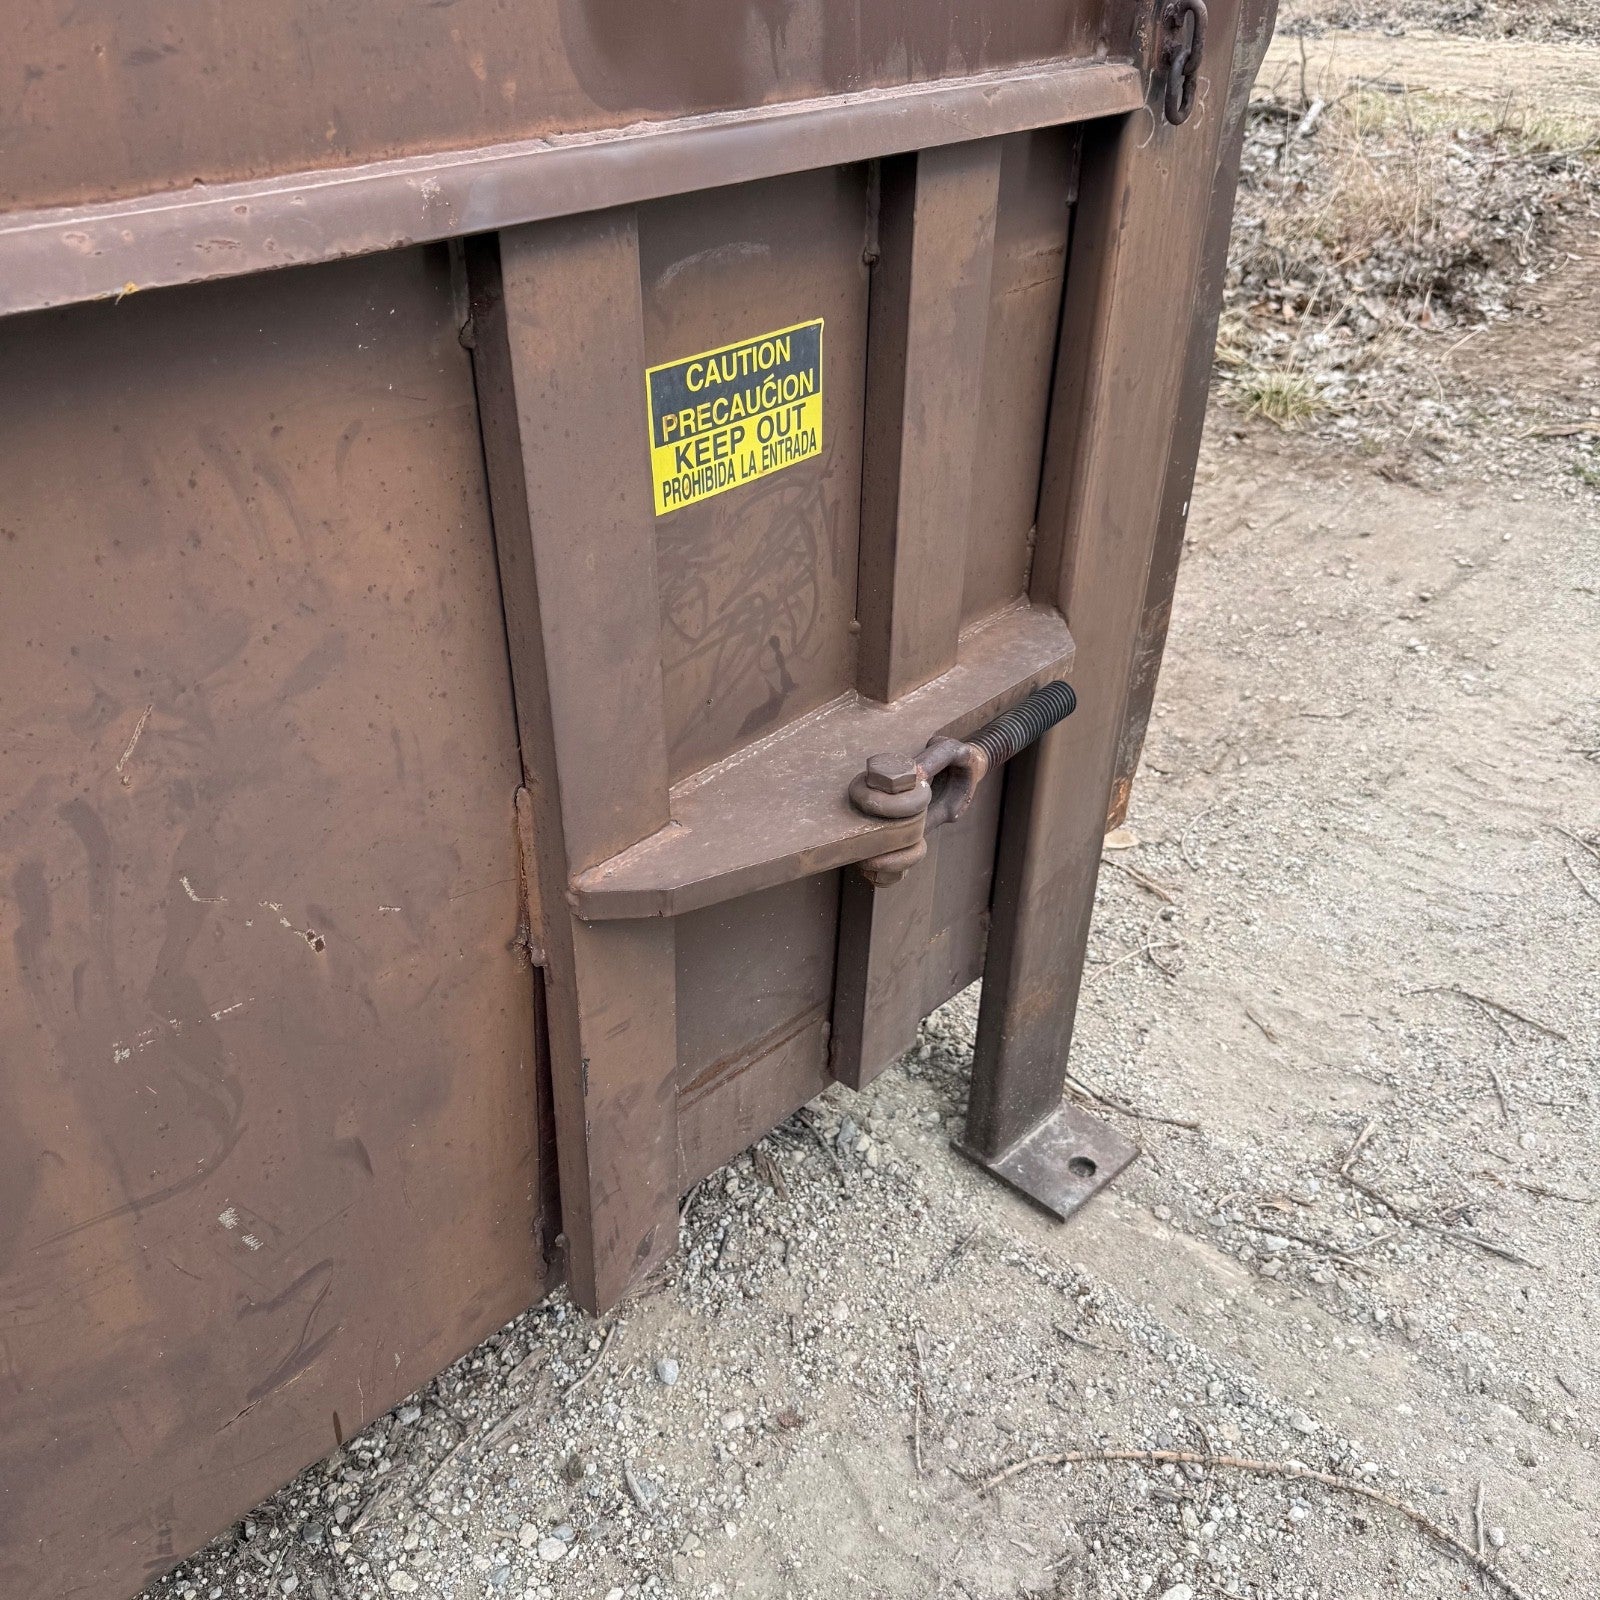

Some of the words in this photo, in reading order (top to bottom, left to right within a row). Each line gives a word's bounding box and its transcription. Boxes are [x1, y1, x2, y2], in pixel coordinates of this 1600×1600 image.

[686, 336, 791, 392] CAUTION
[662, 458, 736, 507] PROHIBIDA
[740, 450, 757, 479] LA
[761, 427, 817, 472] ENTRADA
[675, 426, 745, 474] KEEP
[757, 403, 806, 444] OUT
